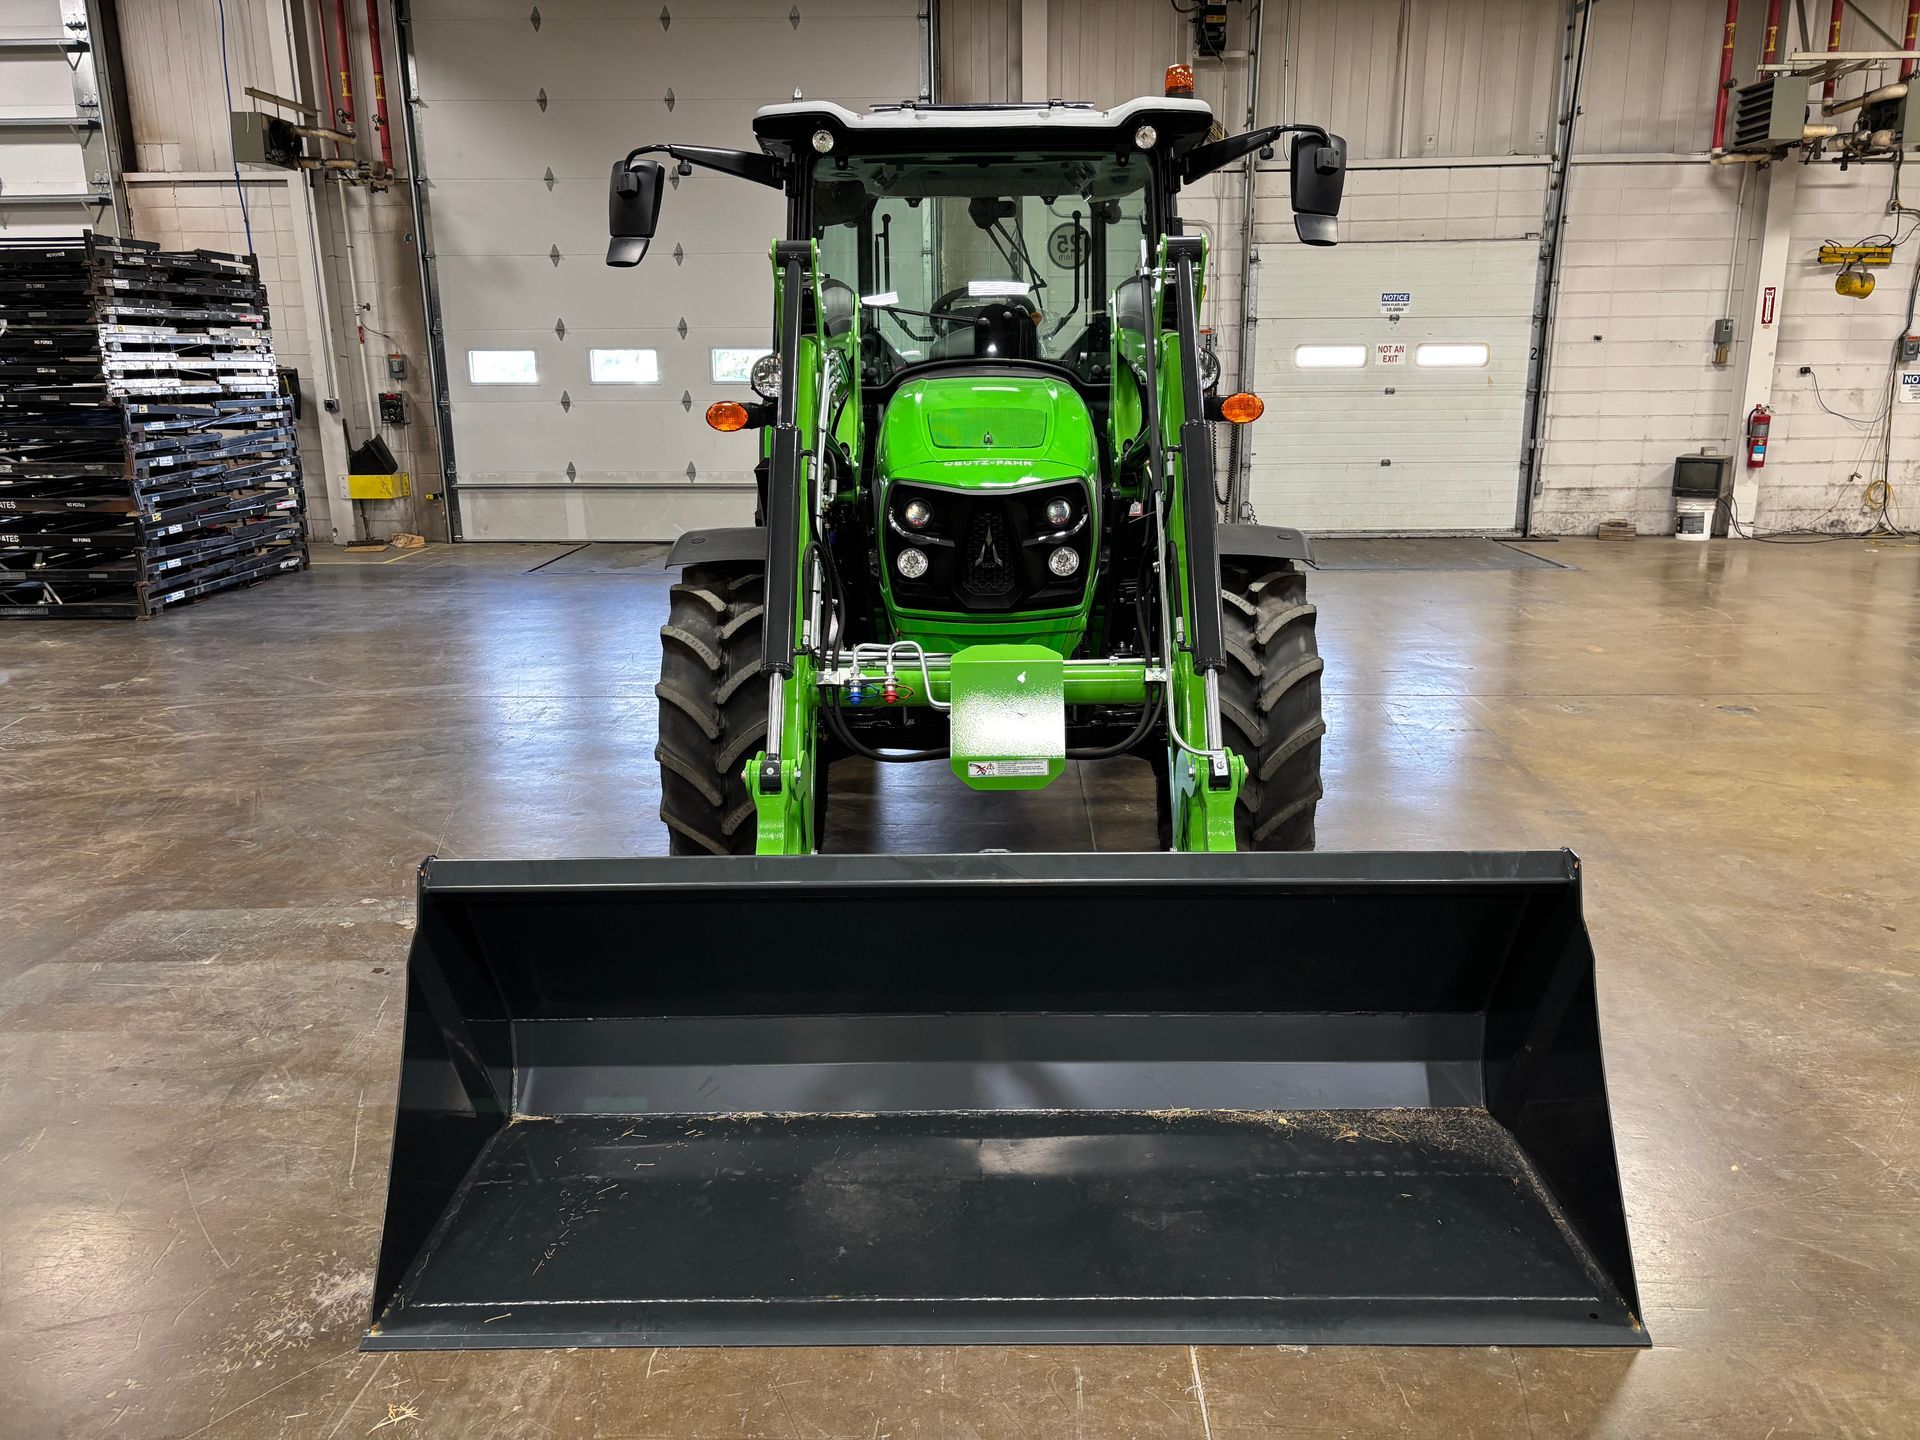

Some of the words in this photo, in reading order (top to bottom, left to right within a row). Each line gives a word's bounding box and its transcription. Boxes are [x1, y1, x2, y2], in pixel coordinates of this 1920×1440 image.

[1378, 345, 1392, 353] NOT
[1394, 345, 1405, 353] AN
[1382, 355, 1398, 363] EXIT
[1904, 375, 1920, 384] NO
[0, 535, 19, 543] ATES
